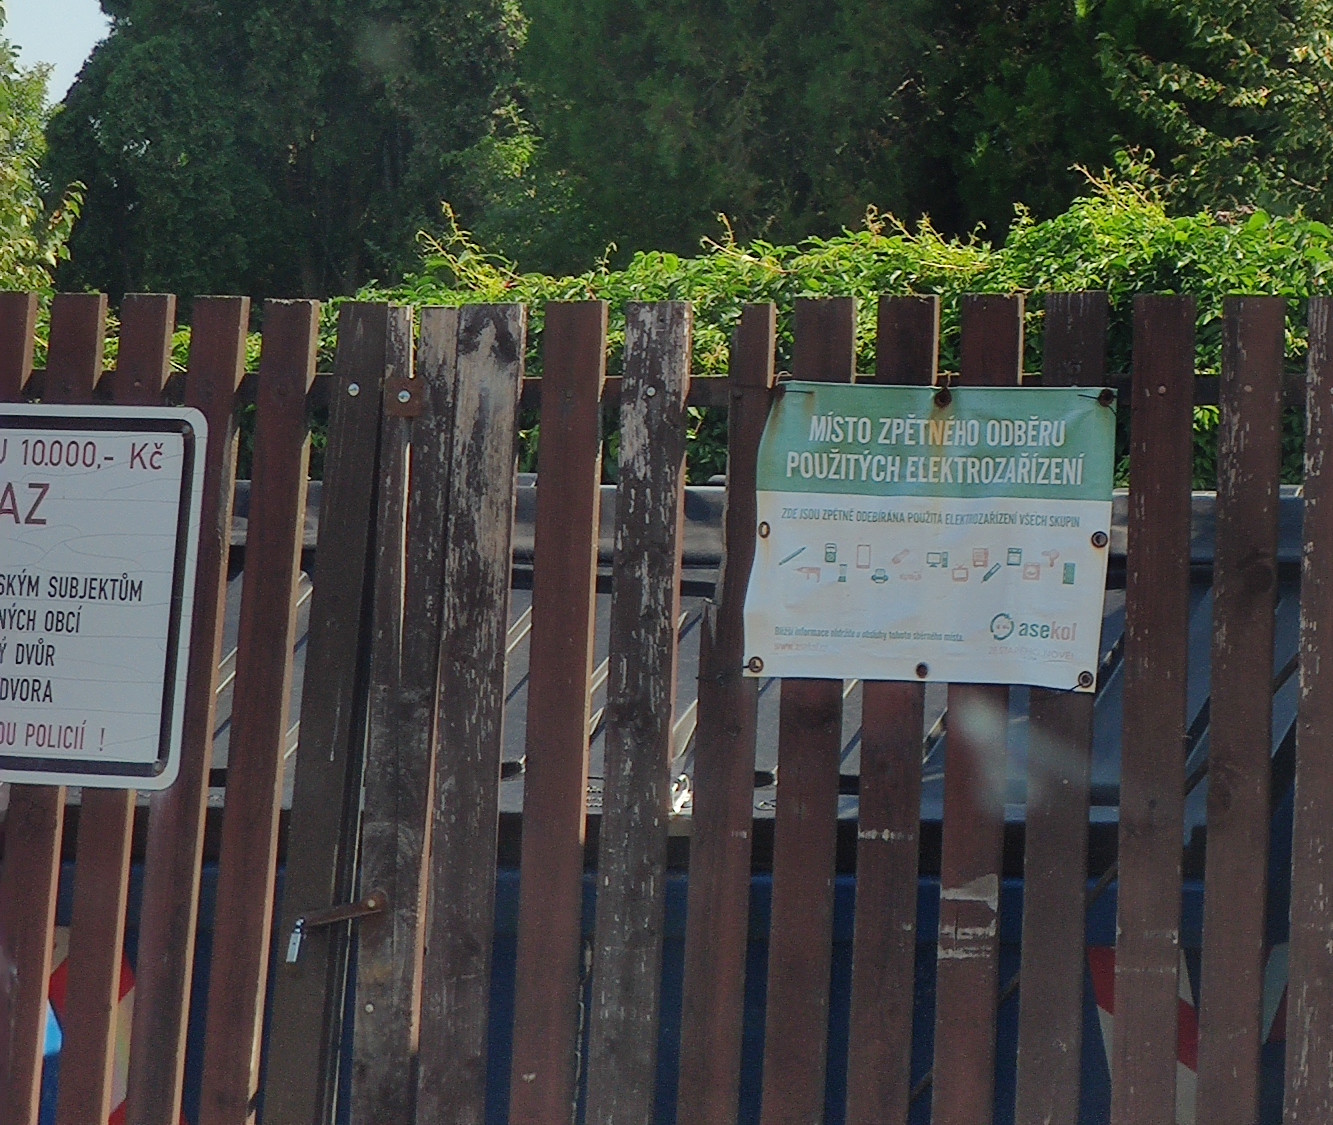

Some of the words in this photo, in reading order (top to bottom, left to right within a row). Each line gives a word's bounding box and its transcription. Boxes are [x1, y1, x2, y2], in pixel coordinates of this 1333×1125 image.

[809, 411, 872, 443] MÍSTO
[878, 414, 980, 446] ZPĚTNÉHO
[986, 416, 1067, 447] ODBĚRU
[22, 439, 114, 469] 10.000,-
[130, 442, 163, 470] Kč
[786, 449, 900, 482] POUŽITÝCH
[906, 453, 1085, 485] ELEKTROZAŘÍZENÍ
[781, 508, 798, 519] ZDE
[799, 509, 820, 520] JSOU
[857, 510, 905, 522] ODEBÍRÁNA
[1020, 512, 1047, 526] VŠECH
[1049, 515, 1080, 527] SKUPIN
[47, 573, 143, 601] SUBJEKTŮM
[44, 606, 81, 633] OBCÍ
[1019, 621, 1077, 641] asekol
[15, 638, 55, 666] DVŮR
[25, 720, 86, 750] POLICIÍ
[99, 727, 105, 751] !
